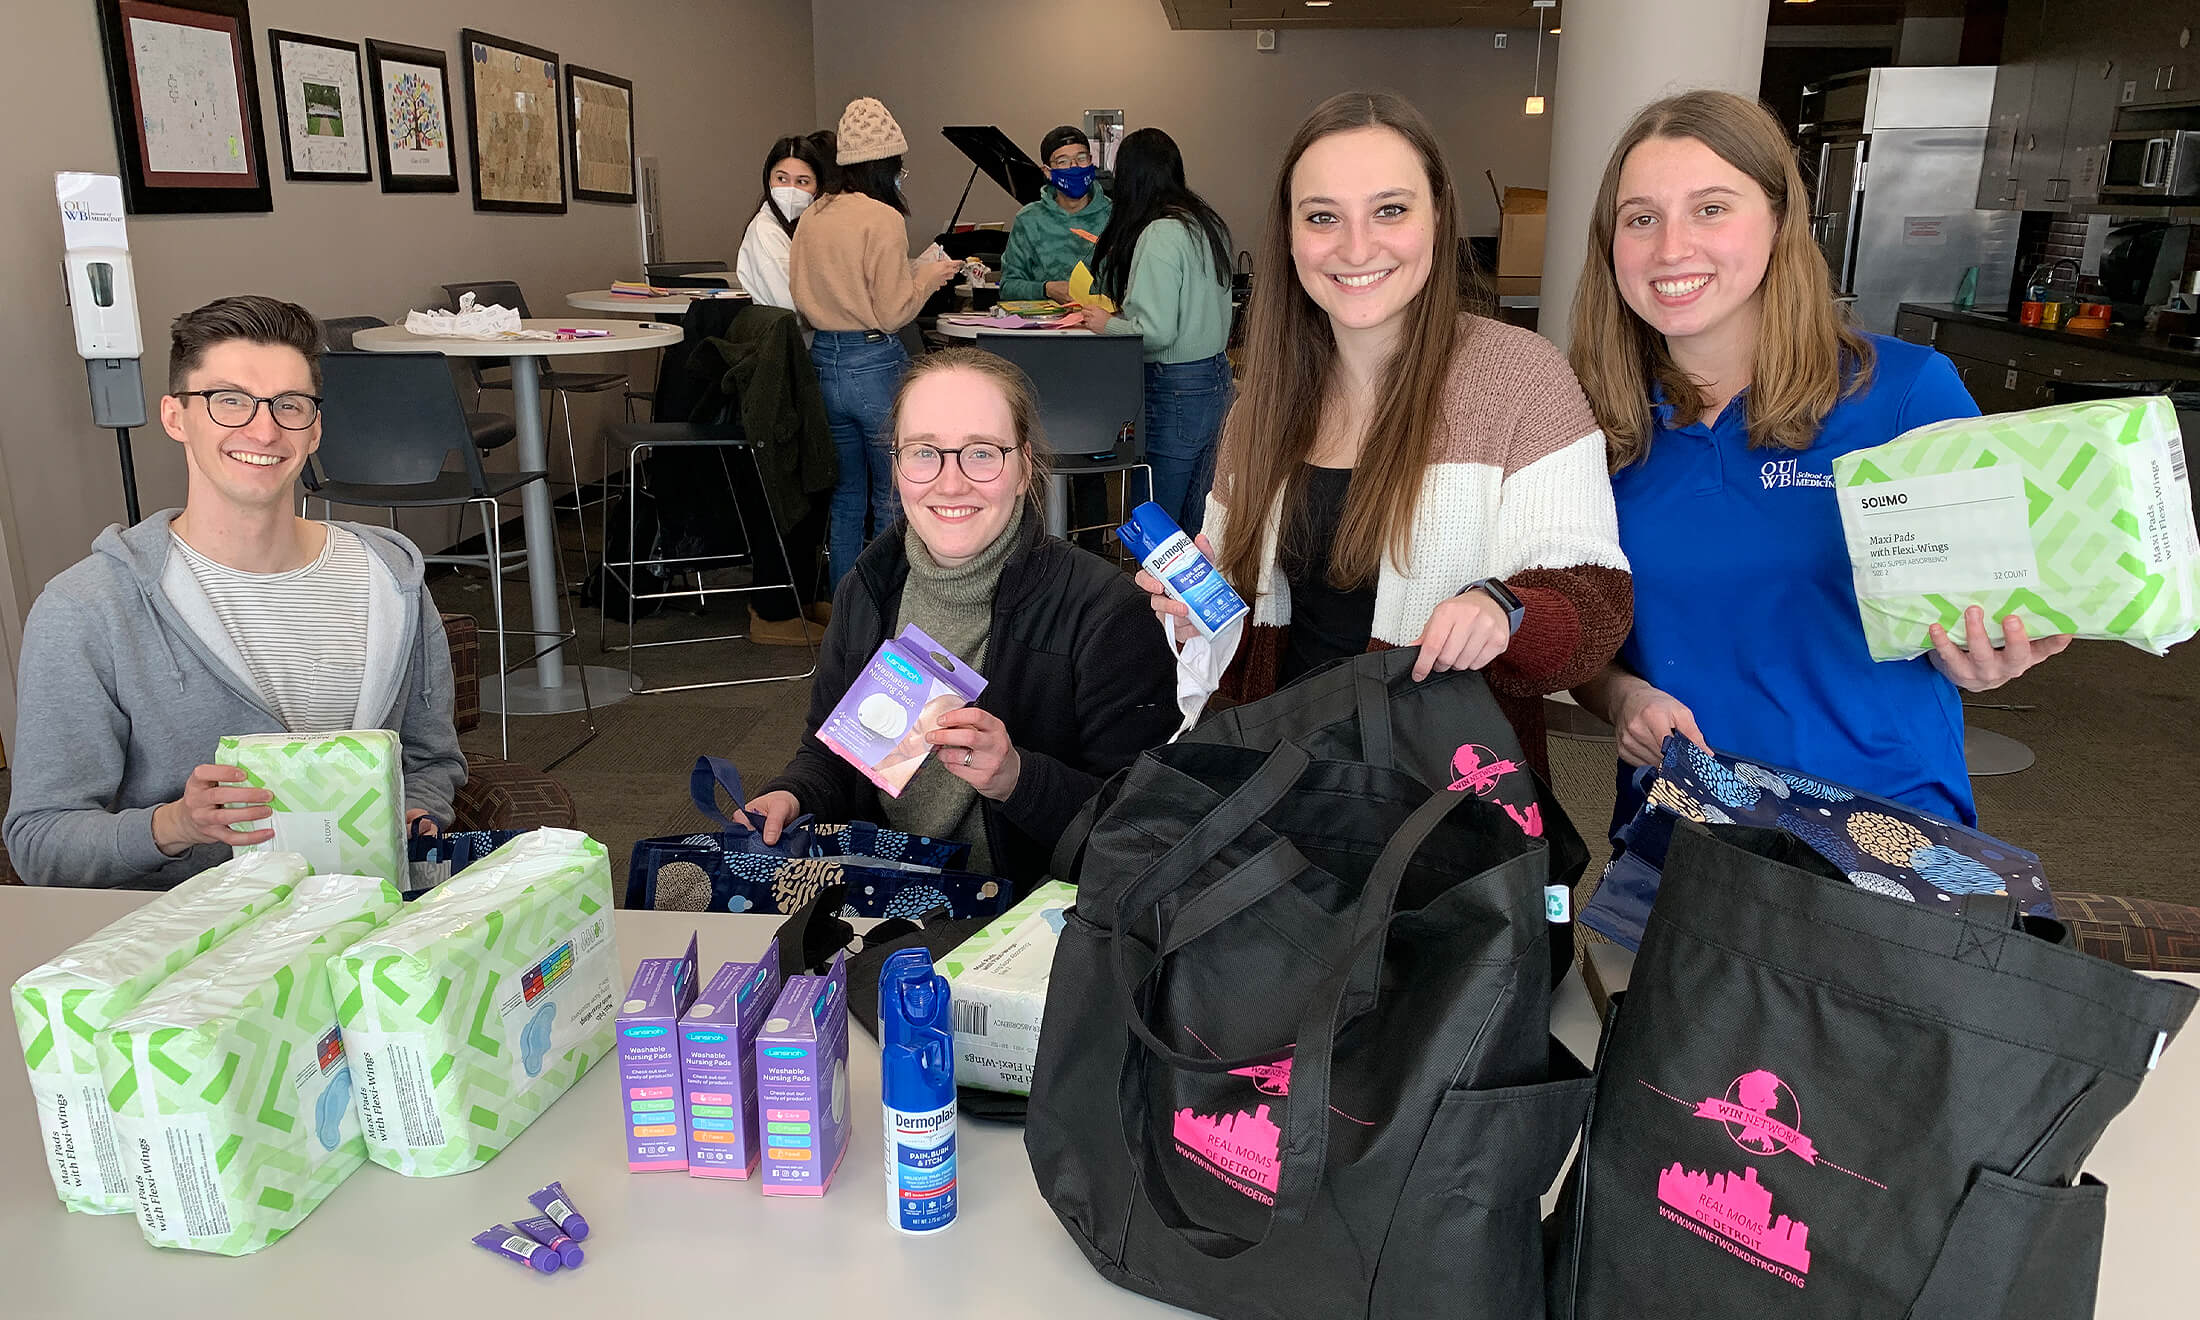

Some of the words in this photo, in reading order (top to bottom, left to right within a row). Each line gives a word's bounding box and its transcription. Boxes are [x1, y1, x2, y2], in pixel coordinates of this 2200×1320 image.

[64, 200, 86, 211] OU
[65, 211, 88, 221] WB
[1761, 460, 1794, 475] OU
[1797, 471, 1822, 480] School
[1760, 474, 1792, 489] WB
[1796, 478, 1835, 488] MEDICIN
[2152, 459, 2167, 530] Flexi-Wings
[1861, 493, 1908, 509] SOLIMO
[2147, 504, 2158, 533] Pads
[1869, 534, 1892, 546] Maxi
[1894, 531, 1916, 543] Pads
[1870, 547, 1891, 558] with
[1892, 543, 1950, 556] Flexi-Wings
[2149, 536, 2162, 564] Maxi
[2161, 532, 2172, 560] with
[1993, 571, 2002, 580] 32
[2004, 569, 2027, 579] COUNT
[869, 668, 898, 696] Nursing
[896, 690, 916, 707] Pads
[875, 661, 911, 692] Washable
[1454, 778, 1471, 790] WIN
[1470, 763, 1504, 783] NETWORK
[624, 1054, 653, 1062] Nursing
[630, 1046, 666, 1054] Washable
[686, 1058, 713, 1067] Nursing
[965, 1053, 1023, 1072] Flexi-Wings
[363, 1052, 383, 1115] Flexi-Wings
[763, 1074, 792, 1083] Nursing
[768, 1067, 805, 1075] Washable
[1000, 1072, 1024, 1084] Pads
[360, 1087, 371, 1112] Pads
[56, 1093, 76, 1160] Flexi-Wings
[364, 1113, 377, 1140] Maxi
[376, 1117, 388, 1142] with
[1718, 1104, 1742, 1119] WIN
[1744, 1112, 1801, 1144] NETWORK
[53, 1131, 64, 1157] Pads
[1208, 1134, 1232, 1153] REAL
[1235, 1146, 1273, 1169] MOMS
[56, 1159, 71, 1186] Maxi
[139, 1138, 161, 1205] Flexi-Wings
[924, 1155, 943, 1166] ITCH
[1205, 1148, 1219, 1162] OF
[1220, 1157, 1269, 1184] DETROIT
[69, 1162, 82, 1187] with
[1175, 1143, 1275, 1207] WWW.WINNETWORKDETRO
[136, 1175, 147, 1201] Pads
[141, 1202, 156, 1229] Maxi
[154, 1206, 167, 1232] with
[1699, 1193, 1724, 1216] REAL
[1727, 1207, 1764, 1236] MOMS
[1695, 1209, 1711, 1222] OF
[1713, 1218, 1762, 1250] DETROIT
[1658, 1205, 1806, 1289] WWW.WINNETWORKDETROIT.ORG
